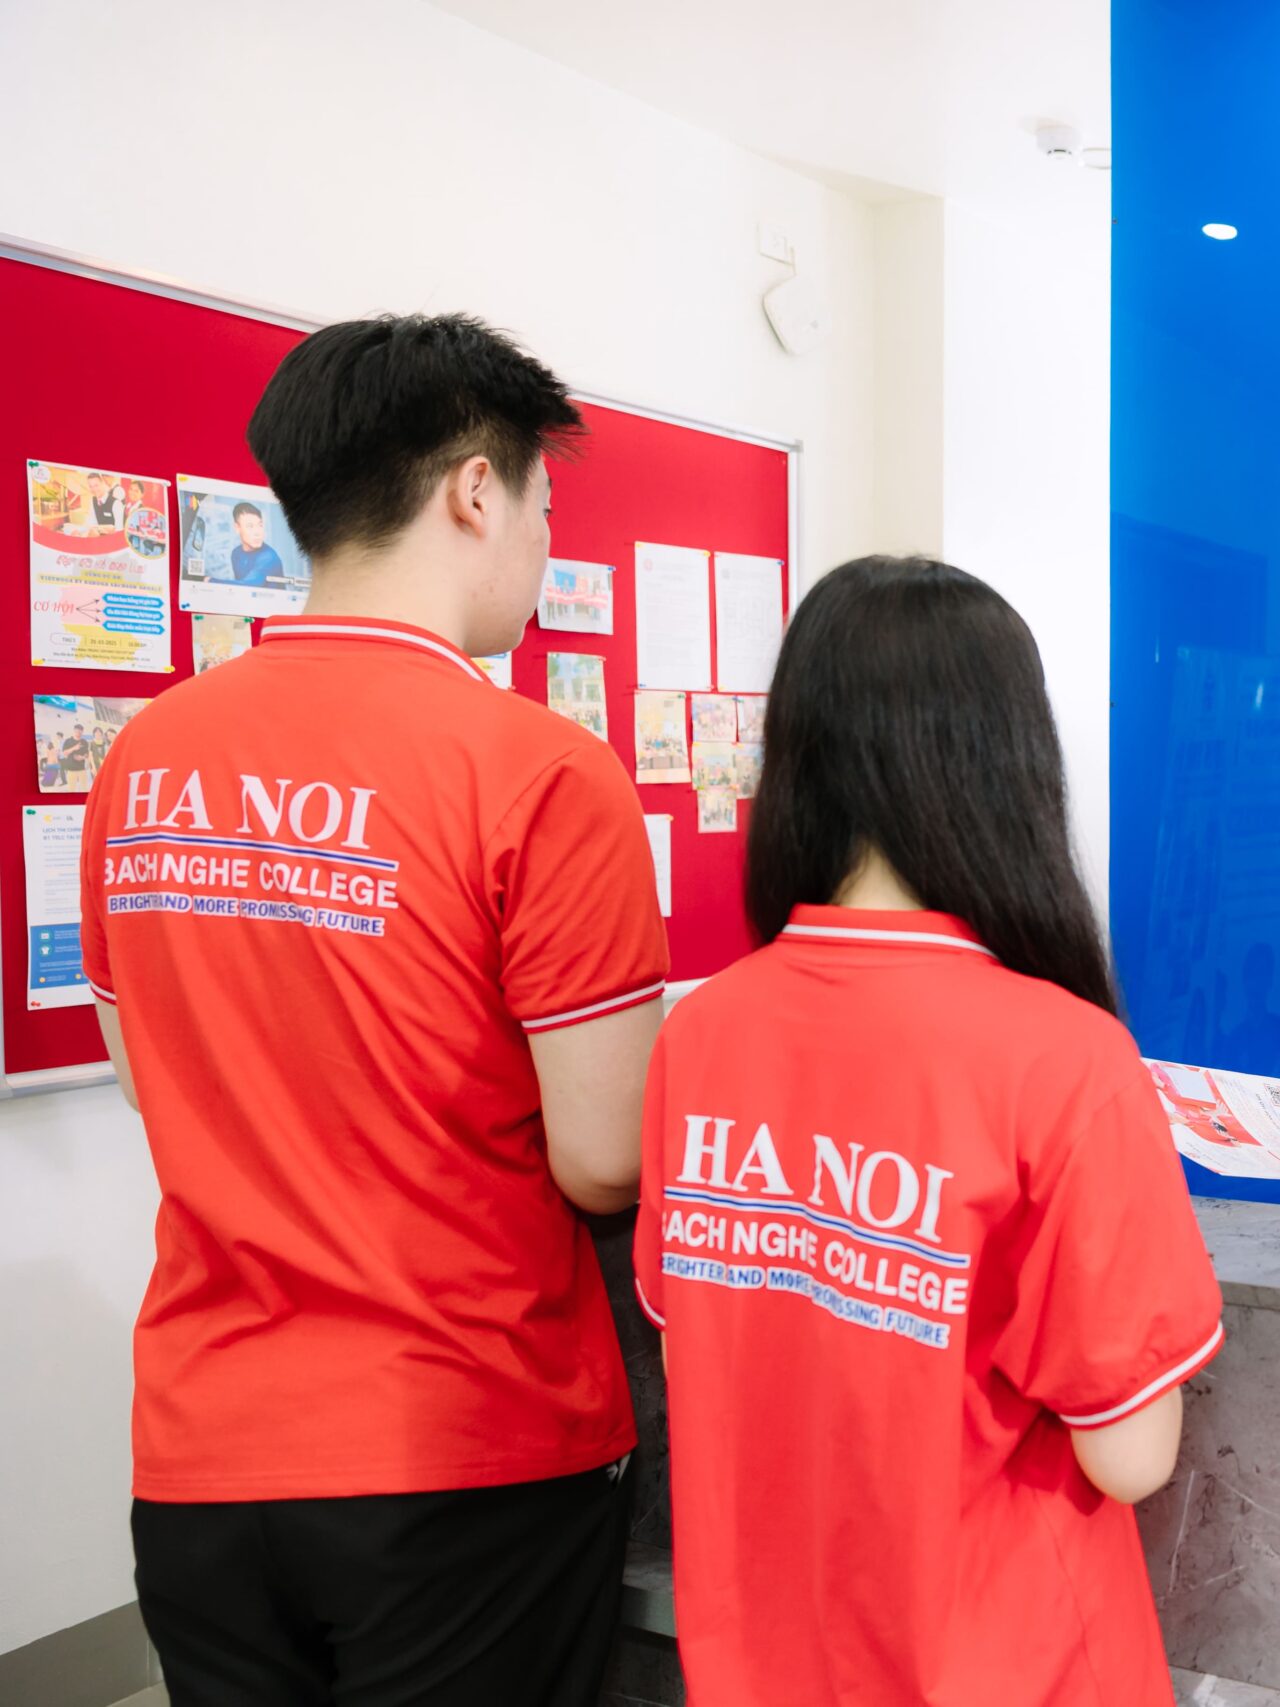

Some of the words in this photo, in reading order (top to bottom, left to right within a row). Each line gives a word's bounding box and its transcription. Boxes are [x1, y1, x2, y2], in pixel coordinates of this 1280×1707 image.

[123, 767, 213, 830] HA
[236, 773, 377, 850] NOI
[160, 853, 251, 888] NGHE
[259, 861, 399, 909] COLLEGE
[194, 898, 237, 915] MORE
[316, 911, 383, 934] FUTURE
[676, 1114, 794, 1197] HA
[807, 1133, 954, 1244] NOI
[662, 1210, 727, 1252] ACH
[731, 1220, 819, 1269] NGHE
[824, 1240, 969, 1315] COLLEGE
[727, 1269, 763, 1286] AND
[886, 1310, 947, 1346] FUTURE
